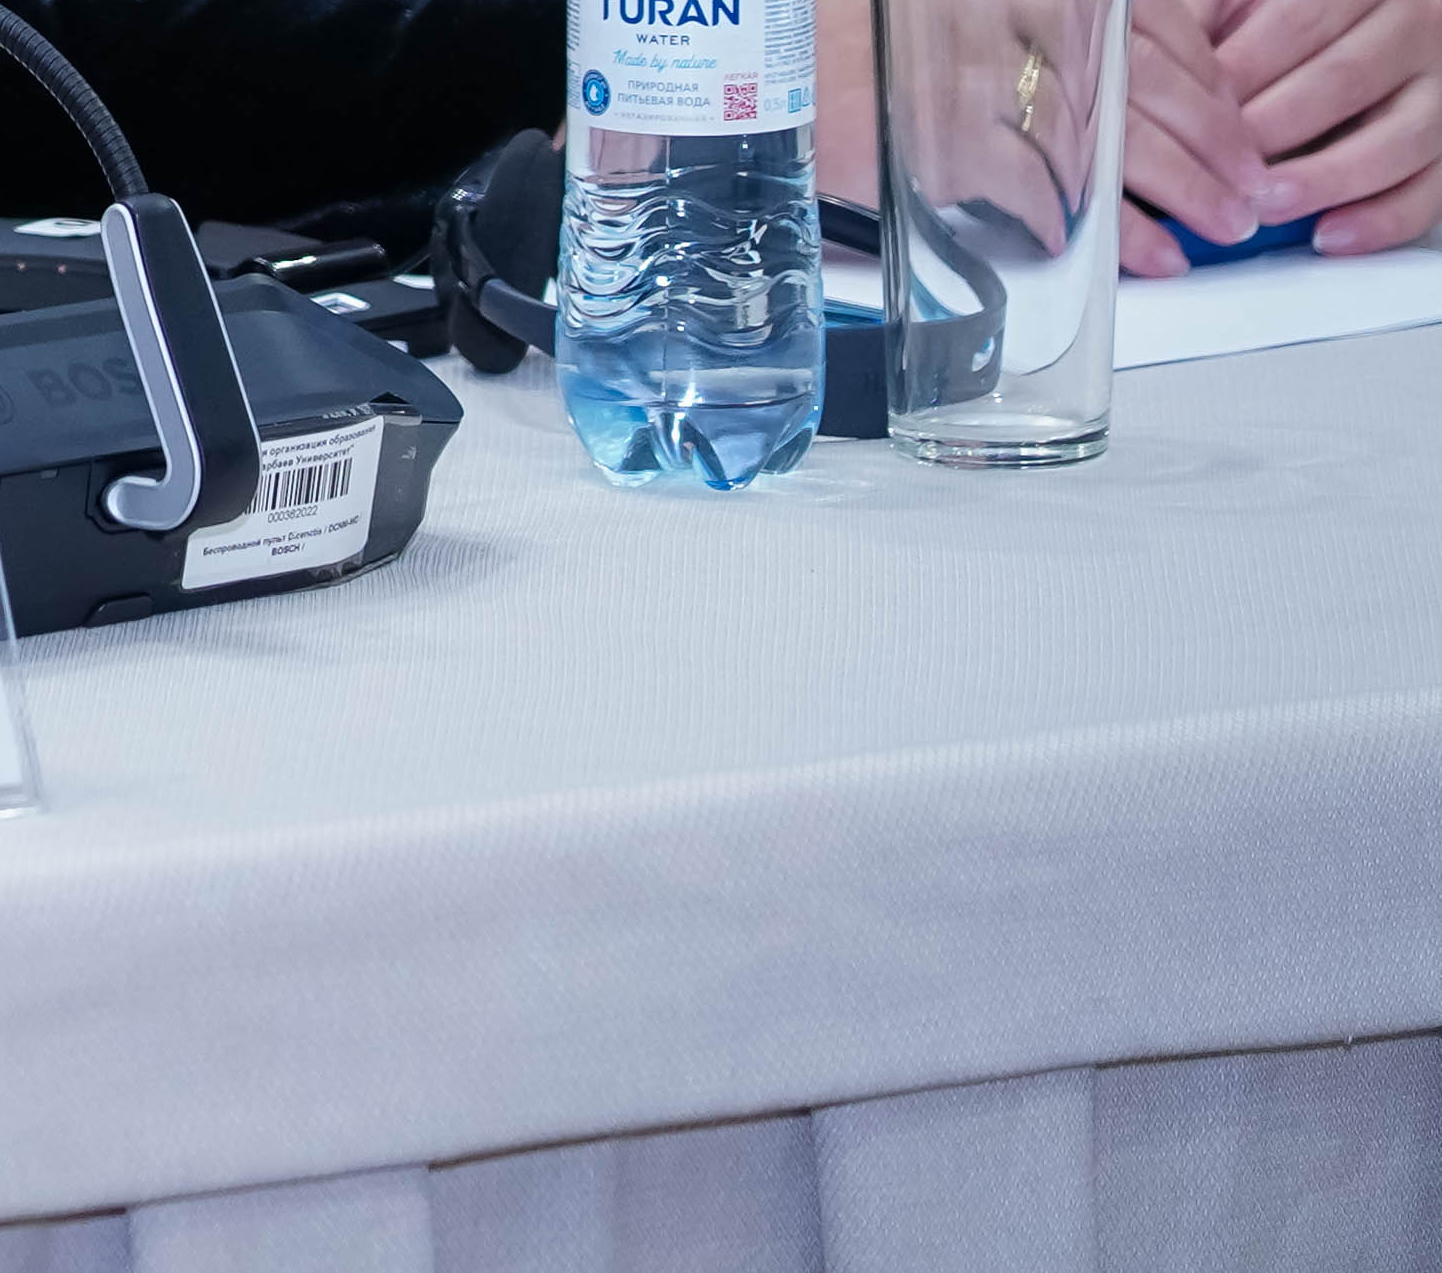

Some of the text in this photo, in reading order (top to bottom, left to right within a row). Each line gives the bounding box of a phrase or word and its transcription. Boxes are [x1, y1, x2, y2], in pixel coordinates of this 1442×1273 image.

[636, 33, 691, 46] WATER
[612, 48, 718, 74] Made by nature
[627, 79, 699, 93] ПРИРОДНАЯ
[617, 92, 712, 108] ПИТЬЕВАЯ ВОДА
[271, 542, 301, 557] BOSCH
